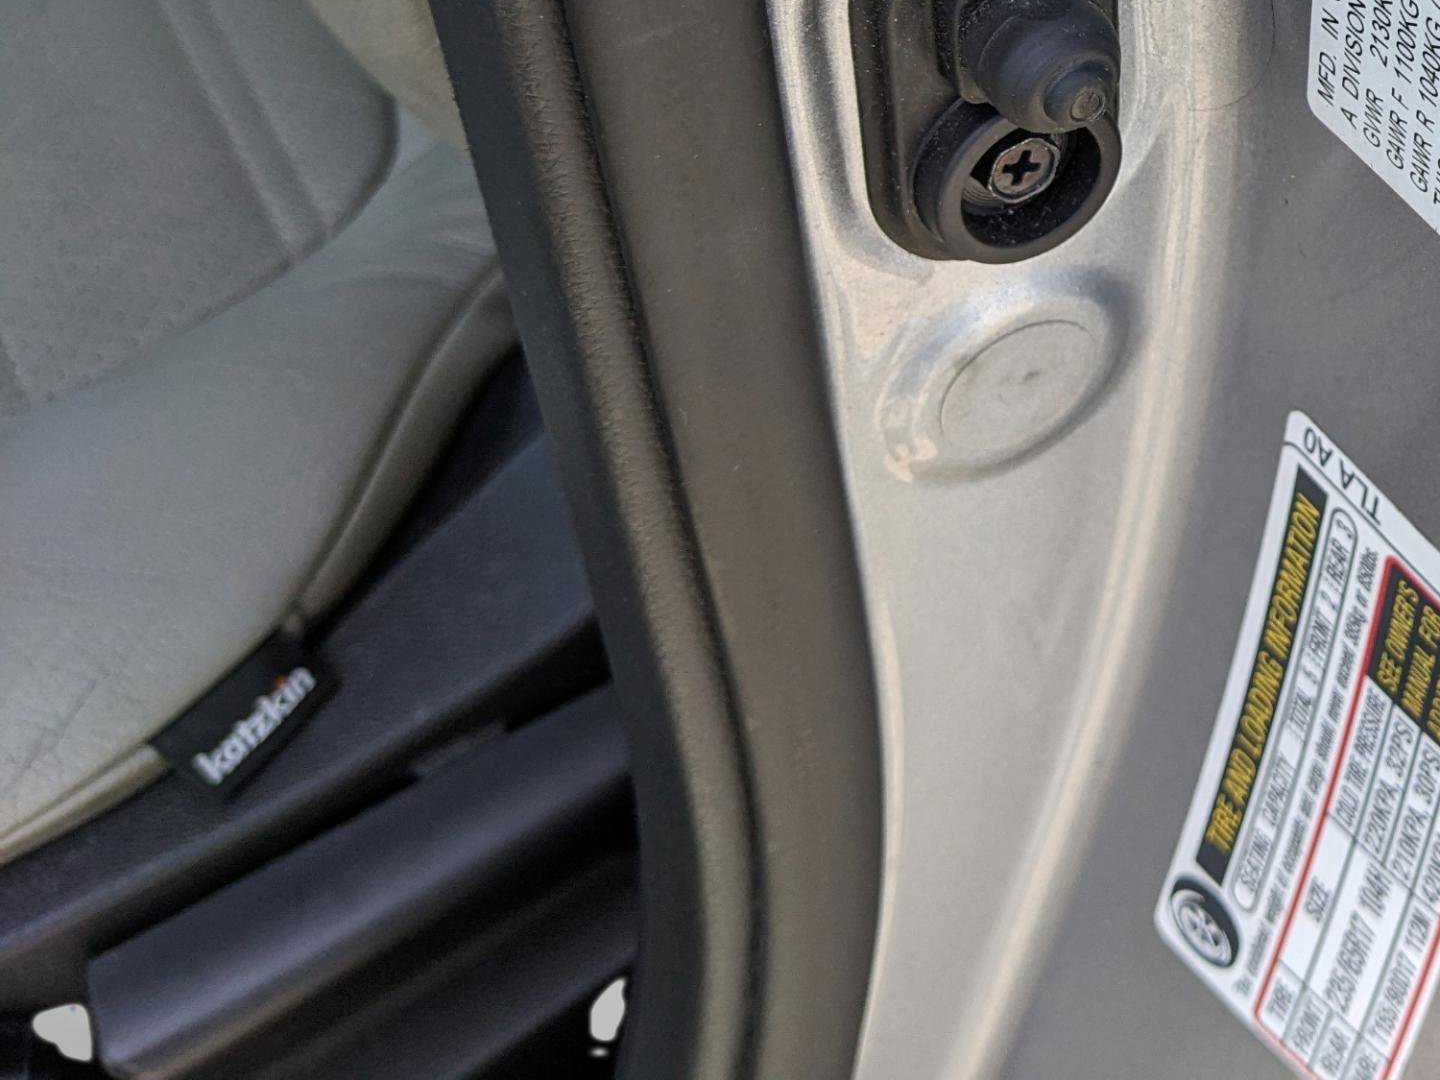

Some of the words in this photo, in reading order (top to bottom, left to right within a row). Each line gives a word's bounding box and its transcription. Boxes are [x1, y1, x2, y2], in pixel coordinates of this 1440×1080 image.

[1321, 7, 1340, 40] IN
[1317, 51, 1337, 107] MFD.
[1391, 86, 1409, 111] F
[1340, 106, 1358, 130] A
[1362, 87, 1384, 148] GVWR
[1385, 109, 1408, 170] GAWR
[1415, 109, 1435, 134] R
[1409, 131, 1433, 193] GAWR
[1340, 459, 1381, 526] TLA
[1264, 493, 1320, 661] INFORMATION
[1385, 579, 1420, 661] OWNER'S
[1377, 651, 1403, 695] SEE
[1401, 644, 1436, 717] MANUAL
[192, 666, 317, 787] katzkin
[1237, 651, 1284, 757] LOADING
[1240, 828, 1272, 894] SEATING
[1263, 752, 1295, 827] CAPACITY
[1308, 608, 1333, 659] FRONT
[1326, 538, 1348, 587] REAR
[1354, 687, 1386, 763] PRESSURE
[1223, 747, 1257, 806] AND
[1344, 755, 1368, 792] TIRE
[1386, 715, 1415, 778] 32PSI
[1206, 792, 1243, 855] TIRE
[1336, 787, 1360, 828] COLD
[1304, 876, 1330, 923] SIZE
[1324, 910, 1376, 1014] 235/65R17
[1359, 861, 1392, 919] 104H
